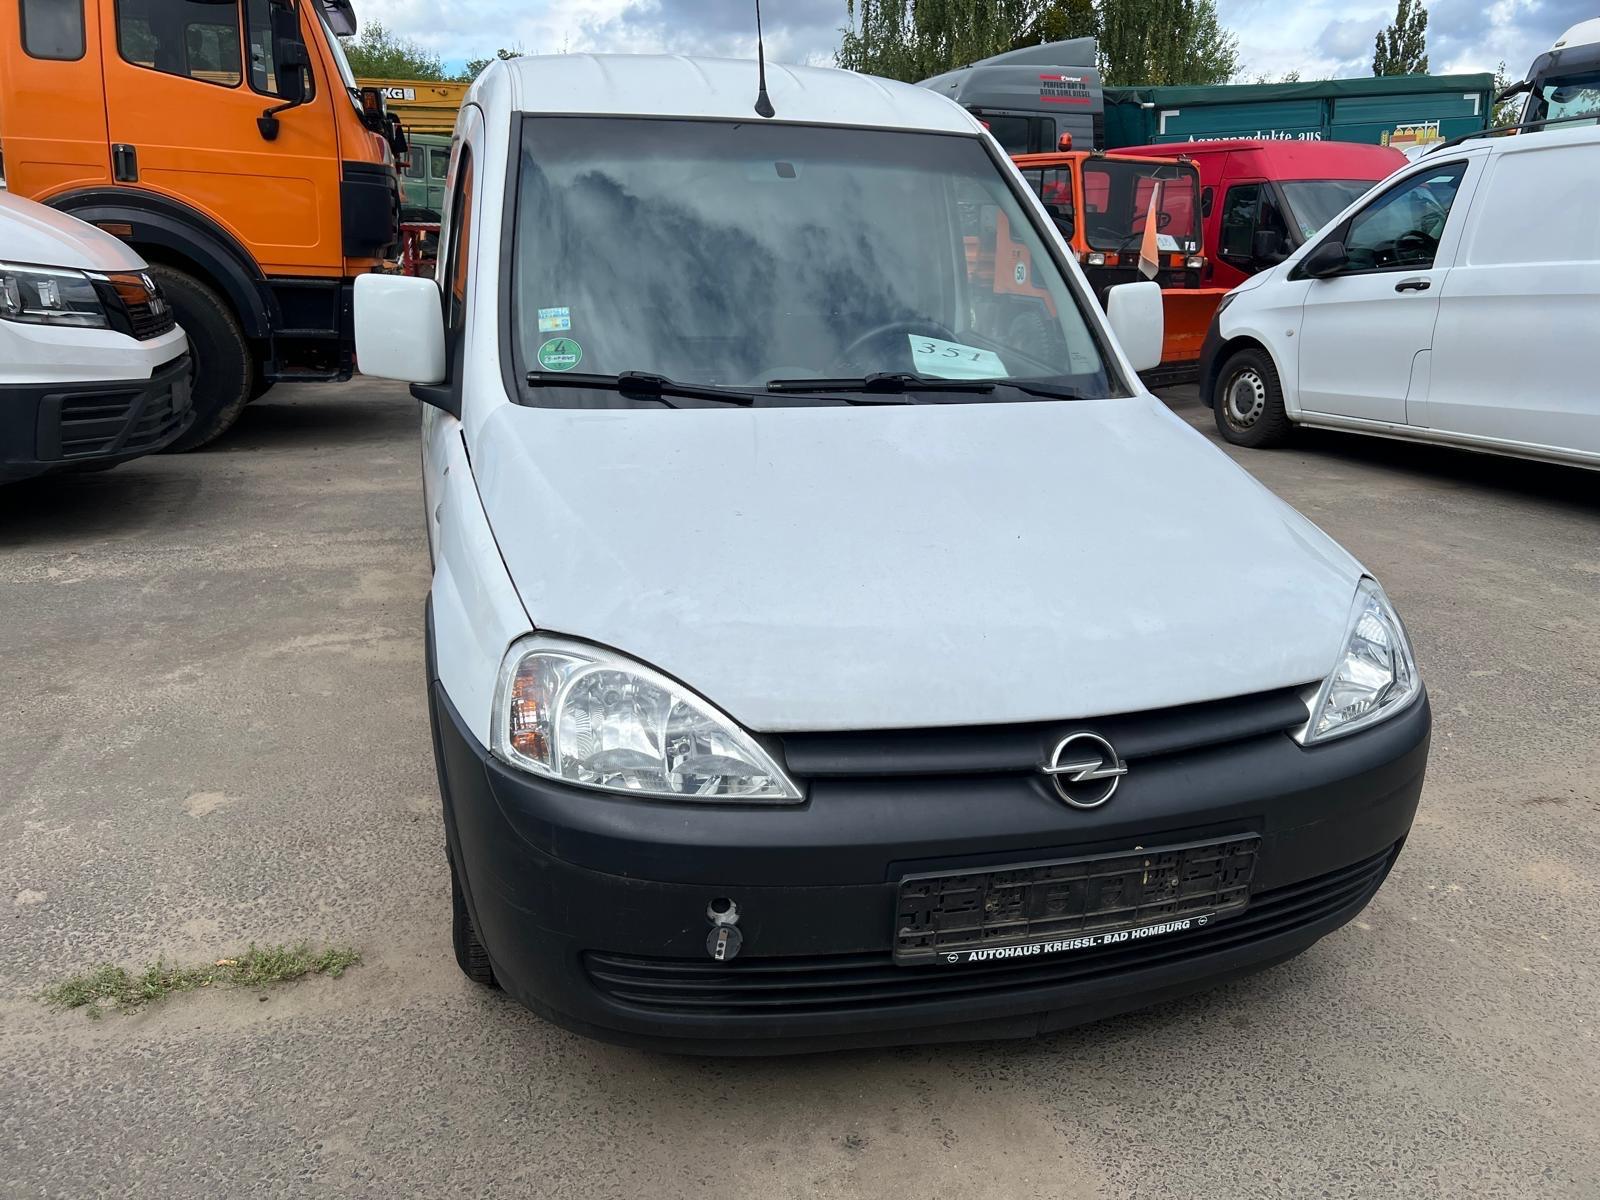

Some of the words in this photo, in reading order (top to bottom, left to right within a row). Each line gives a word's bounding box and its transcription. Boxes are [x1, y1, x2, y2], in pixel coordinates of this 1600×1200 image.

[1043, 81, 1066, 89] PERFECT
[1067, 82, 1079, 90] DAY
[1040, 88, 1056, 96] BURN
[1056, 89, 1072, 97] SOME
[1072, 90, 1091, 98] DIESEL
[1298, 131, 1321, 142] aus
[554, 340, 566, 355] 4
[917, 342, 981, 362] 351
[968, 944, 1041, 962] AUTOHAUS
[1131, 920, 1191, 939] HOMBURG
